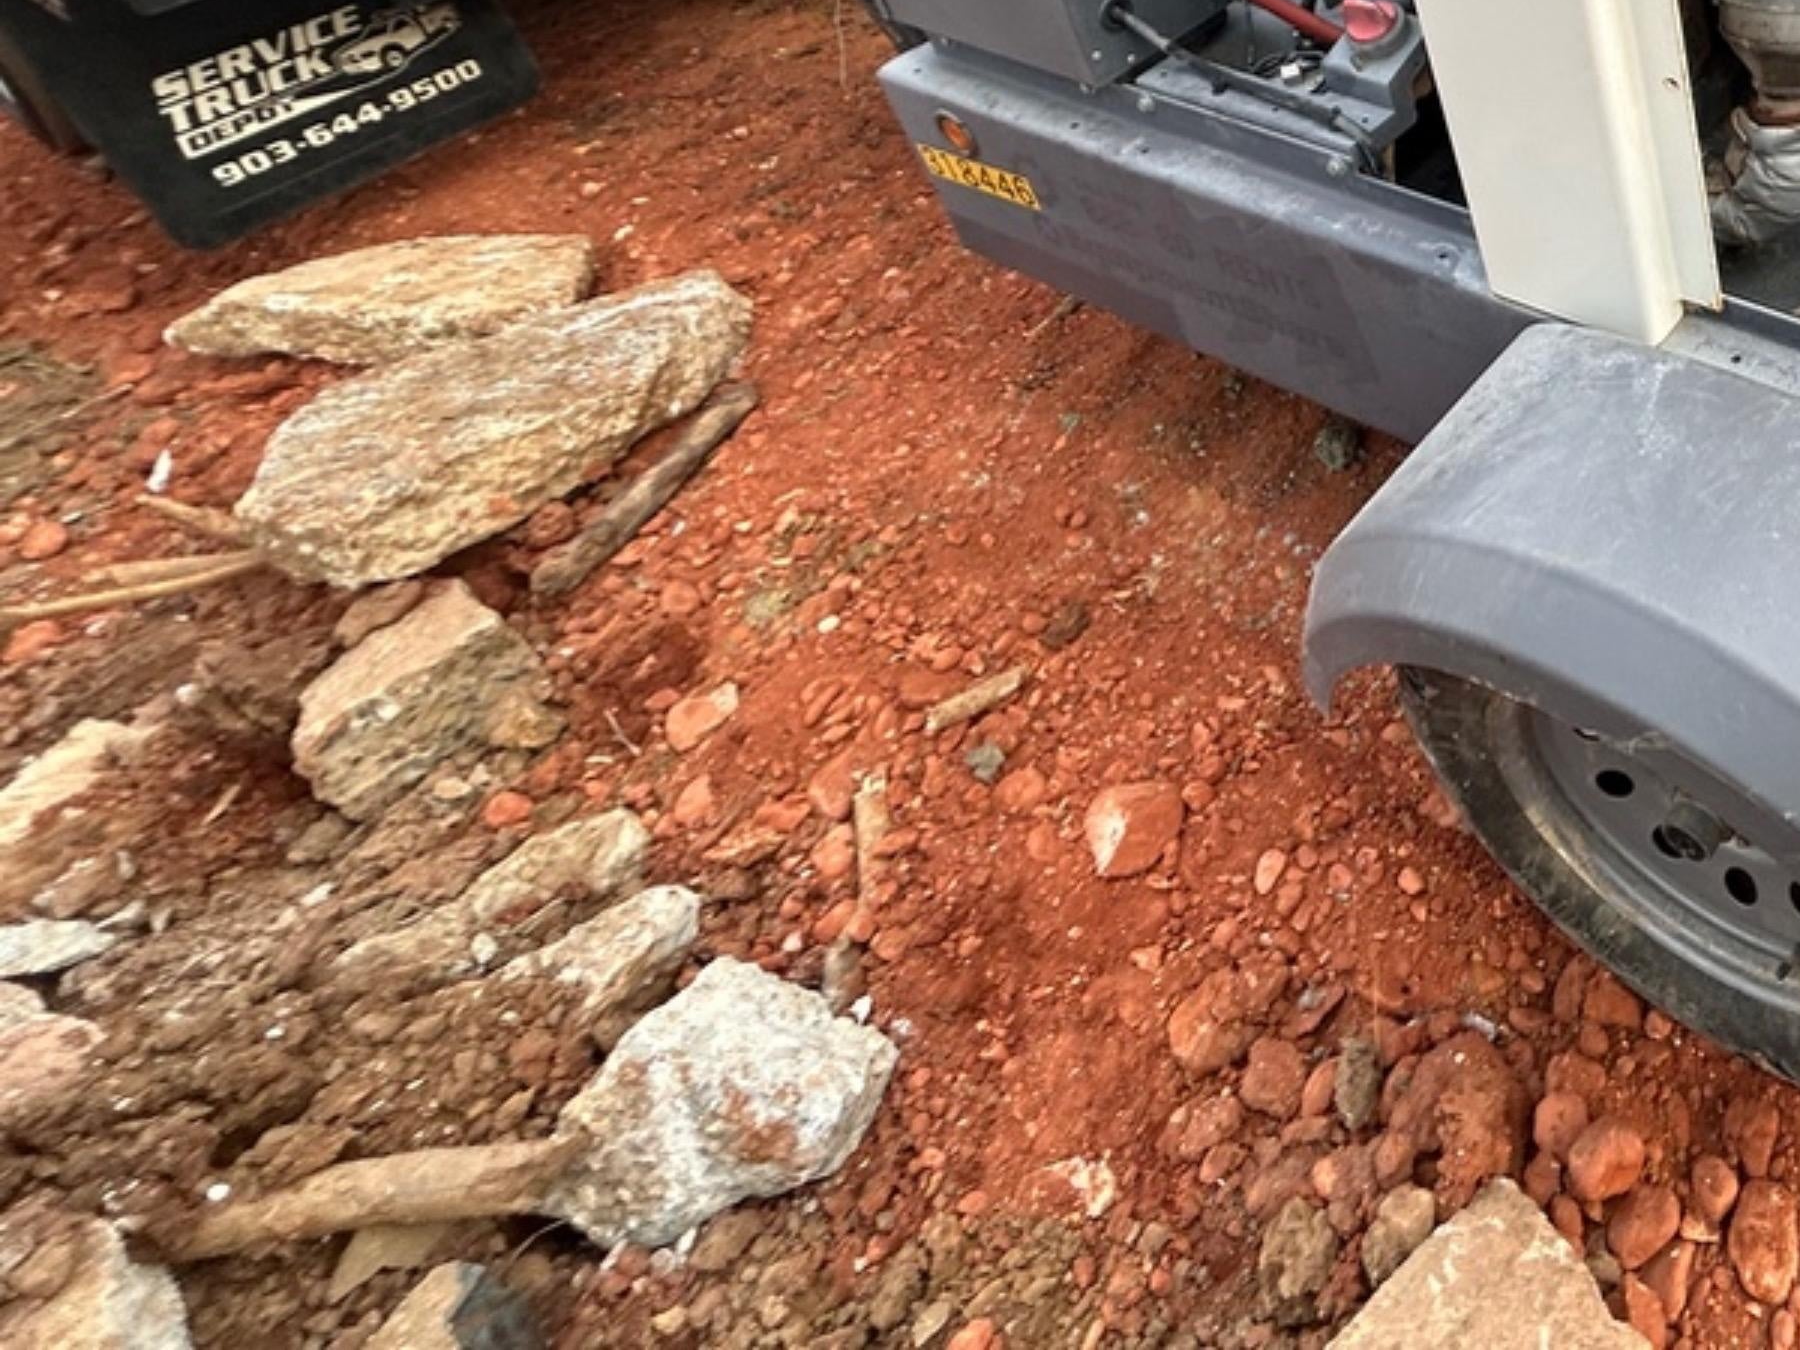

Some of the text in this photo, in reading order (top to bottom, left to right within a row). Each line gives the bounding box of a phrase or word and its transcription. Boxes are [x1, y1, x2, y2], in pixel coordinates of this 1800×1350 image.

[152, 4, 363, 99] SERVICE
[159, 48, 333, 133] TRUCK
[211, 58, 483, 188] 903-644-9500
